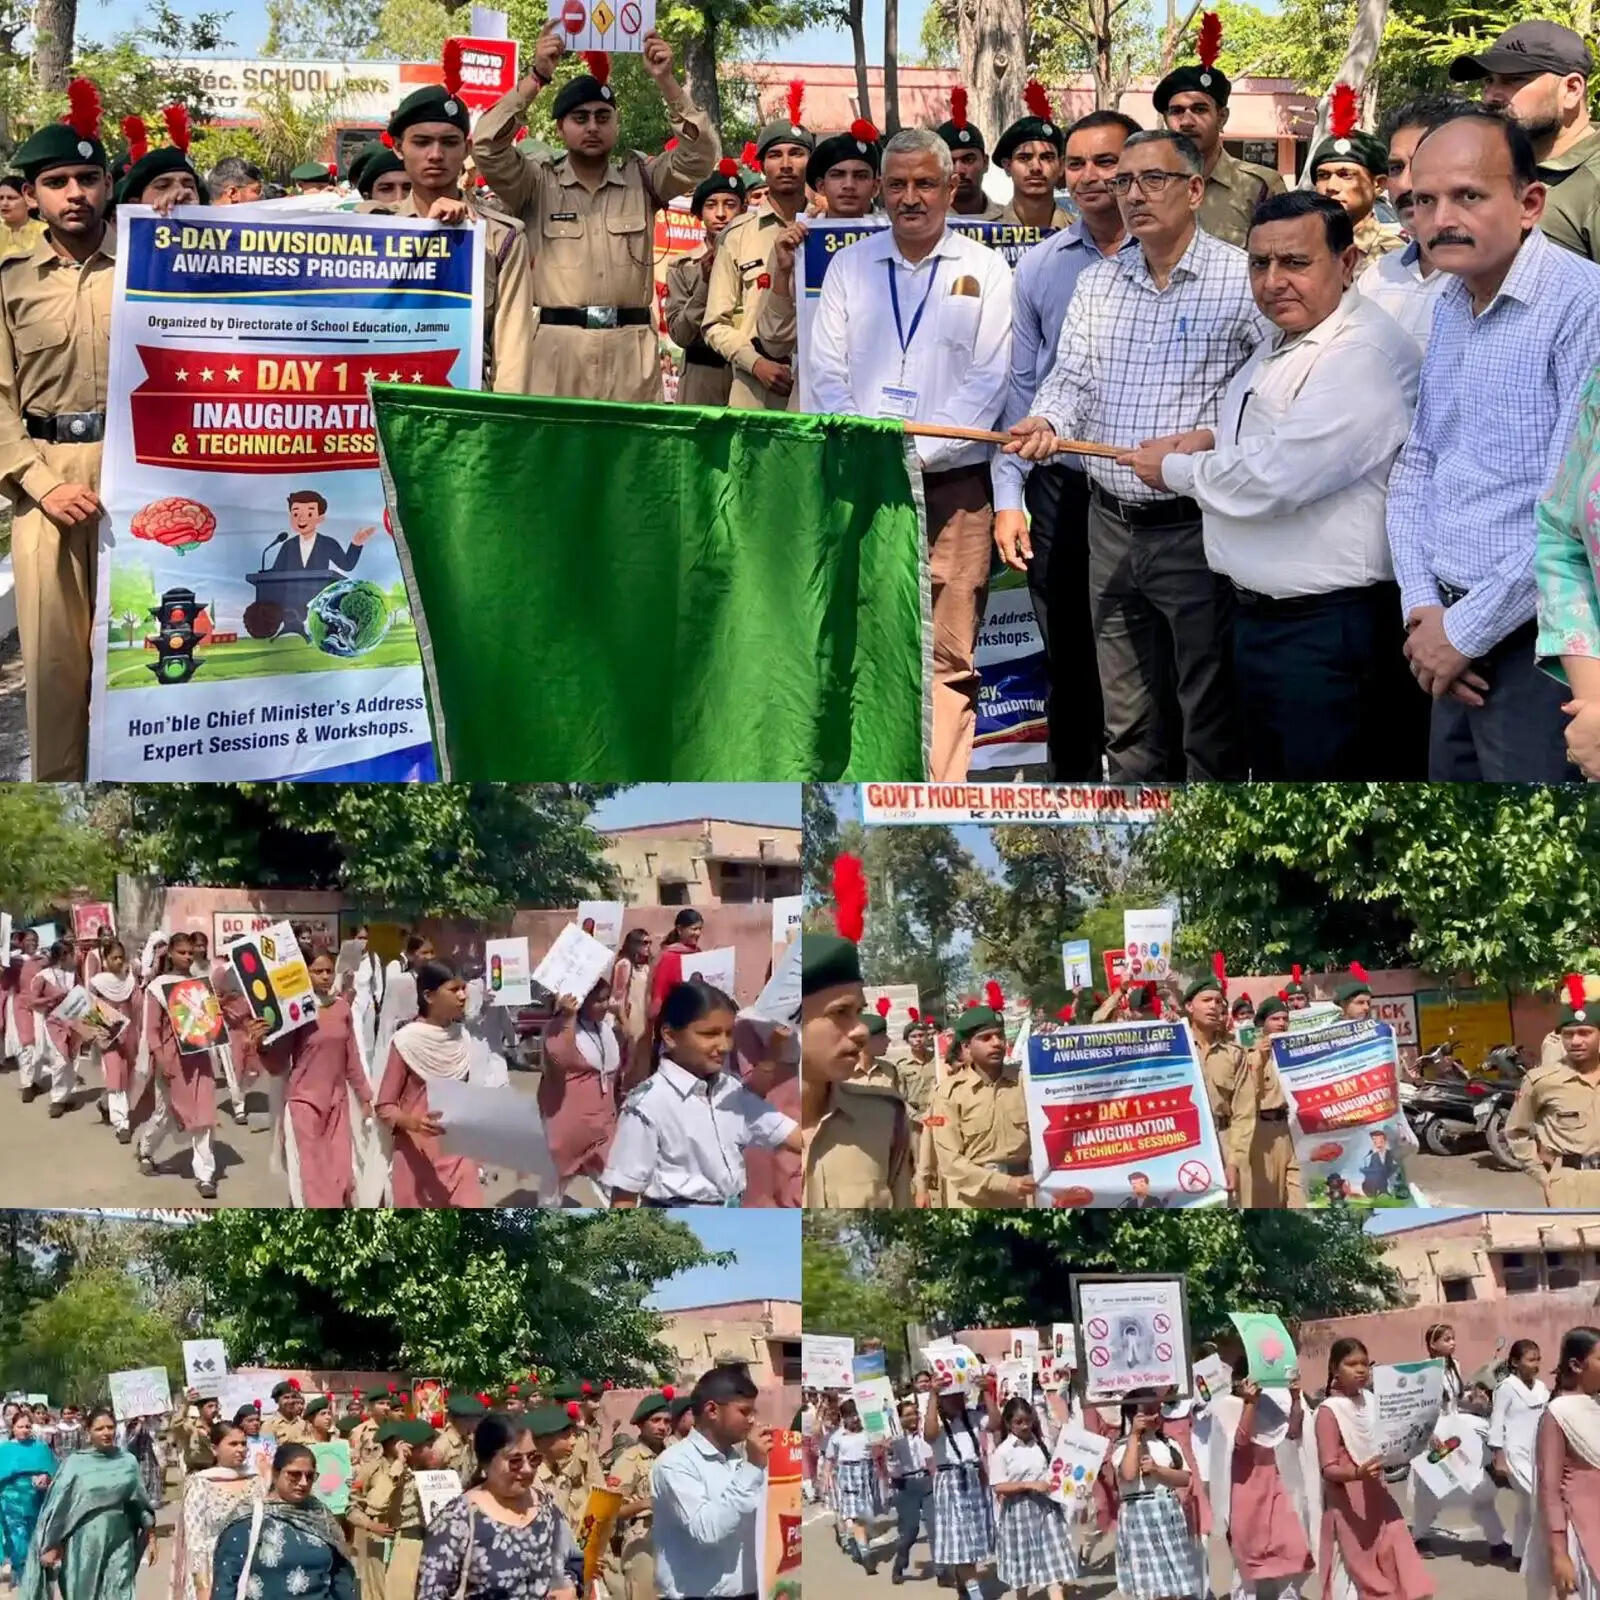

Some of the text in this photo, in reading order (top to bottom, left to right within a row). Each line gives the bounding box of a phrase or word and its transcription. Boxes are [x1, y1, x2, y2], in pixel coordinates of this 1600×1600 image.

[243, 68, 337, 94] SCHOOL
[154, 226, 451, 258] 3-DAY DIVISIONAL LEVEL
[992, 226, 1044, 244] LEVEL
[172, 254, 437, 280] AWARENESS PROGRAMME
[148, 315, 450, 334] Organized by Directorate of School Education, Jammu
[257, 360, 348, 391] DAY 1
[172, 433, 188, 454] &
[197, 434, 316, 455] TECHNICAL
[129, 696, 424, 738] Hon'ble Chief Minister's Address
[143, 720, 413, 762] Expert Sessions & Workshops.
[928, 786, 990, 809] MODEL
[970, 810, 1061, 819] KATHUA
[1042, 1027, 1176, 1050] 3-DAY DIVISIONAL LEVEL
[1054, 1042, 1171, 1062] AWARENESS PROGRAMME
[1332, 1078, 1359, 1097] DAY
[1099, 1099, 1142, 1121] DAY 1
[1073, 1116, 1175, 1147] INAUGURATION
[1064, 1131, 1187, 1163] & TECHNICAL SESSIONS
